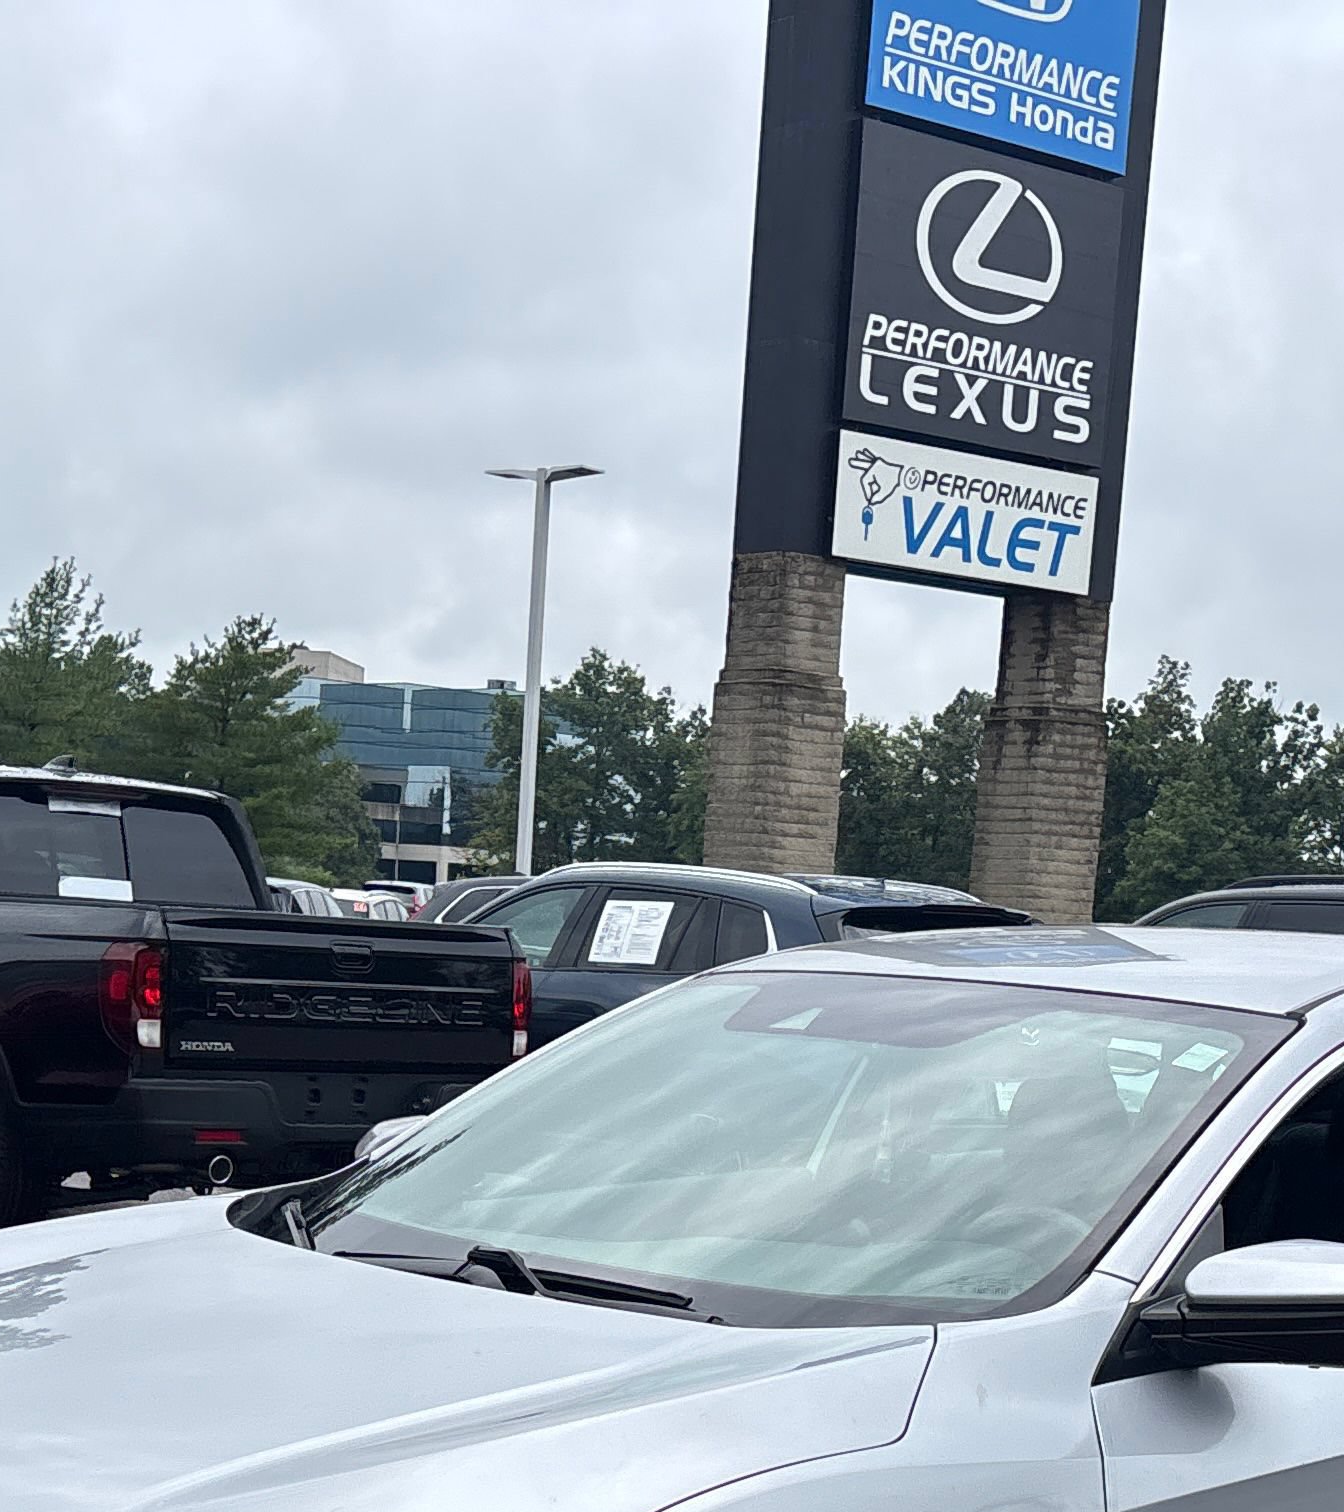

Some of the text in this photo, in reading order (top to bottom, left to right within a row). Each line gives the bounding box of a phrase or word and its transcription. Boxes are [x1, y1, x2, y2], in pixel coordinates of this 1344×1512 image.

[885, 10, 1121, 110] PERFORMANCE
[881, 55, 1115, 151] KINGS Honda
[862, 313, 1094, 392] PERFORMANCE
[859, 353, 1091, 444] LEXUS
[921, 469, 1089, 520] PERFORMANCE
[902, 495, 1082, 577] VALET
[179, 1040, 235, 1052] HONDA
[206, 991, 484, 1026] RIDGELINE
